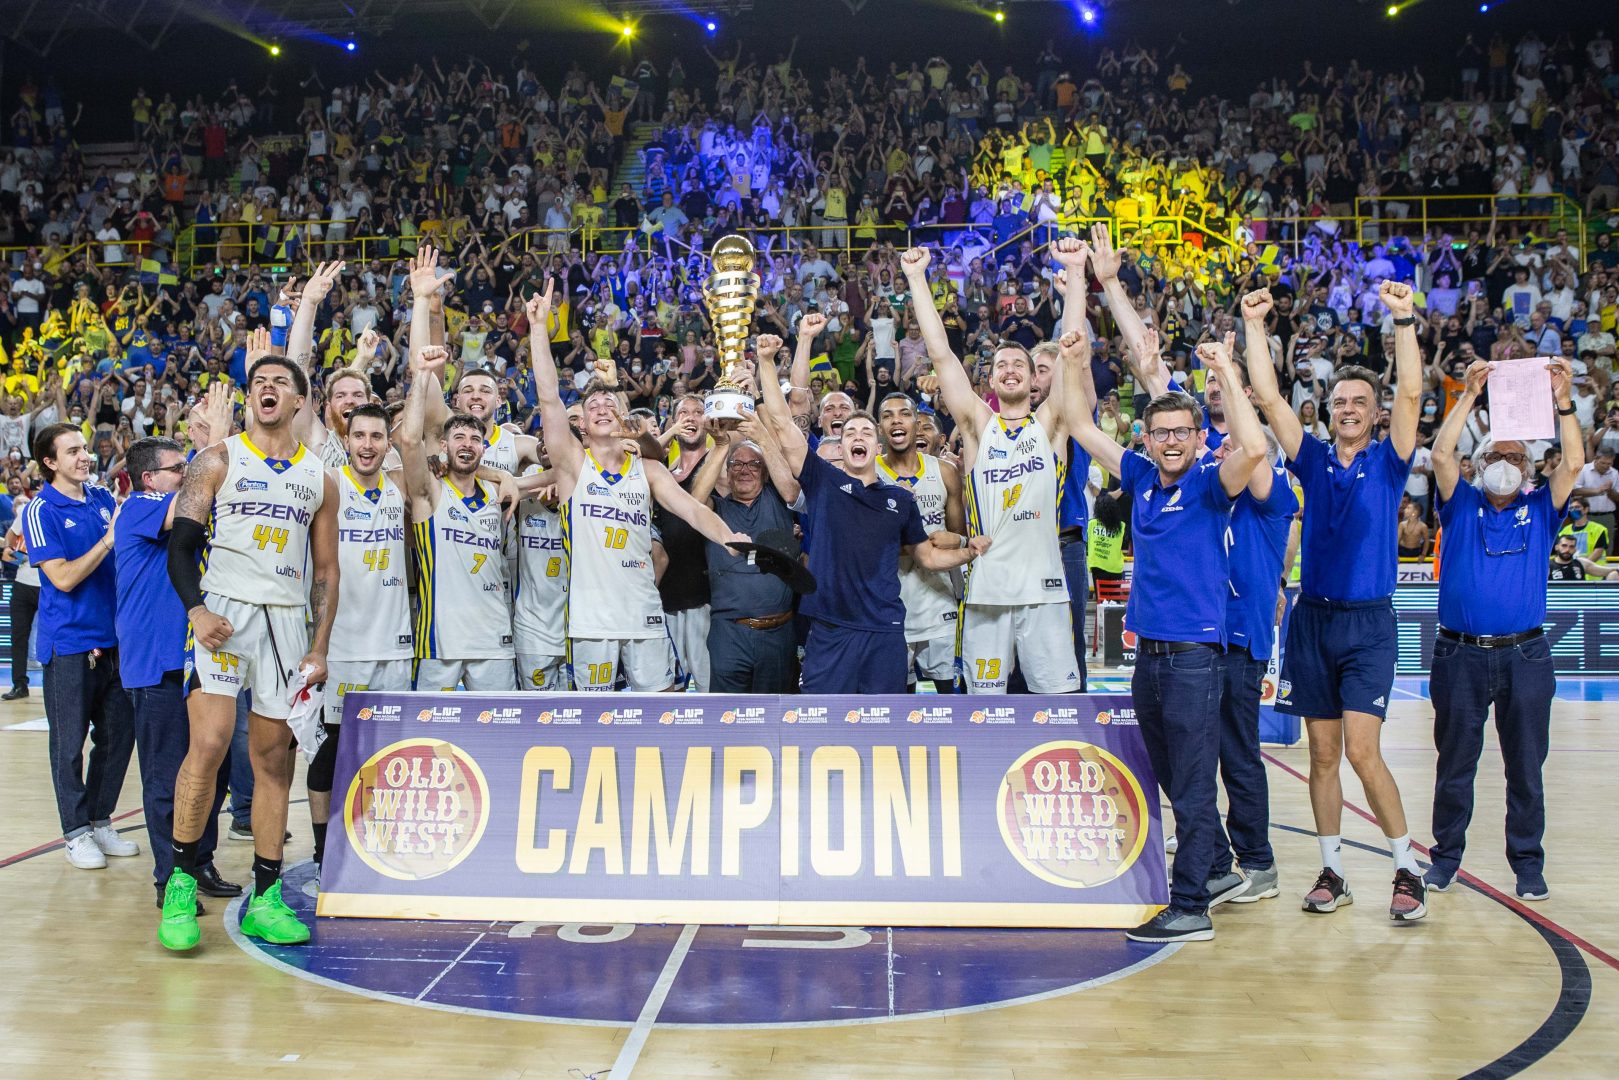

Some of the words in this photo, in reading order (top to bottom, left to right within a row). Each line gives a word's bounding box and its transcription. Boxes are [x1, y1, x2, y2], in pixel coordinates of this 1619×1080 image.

[293, 491, 311, 501] TOP
[252, 524, 289, 553] 44
[604, 526, 629, 549] 10
[363, 549, 390, 571] 45
[470, 553, 487, 574] 7
[546, 557, 561, 577] 6
[588, 662, 613, 685] 10
[975, 658, 1001, 680] 13
[384, 757, 454, 789] OLD
[1032, 760, 1106, 793] OLD
[373, 788, 462, 822] WILD
[515, 745, 963, 877] CAMPIONI
[1023, 794, 1119, 827] WILD
[364, 820, 465, 855] WEST
[1020, 827, 1126, 862] WEST
